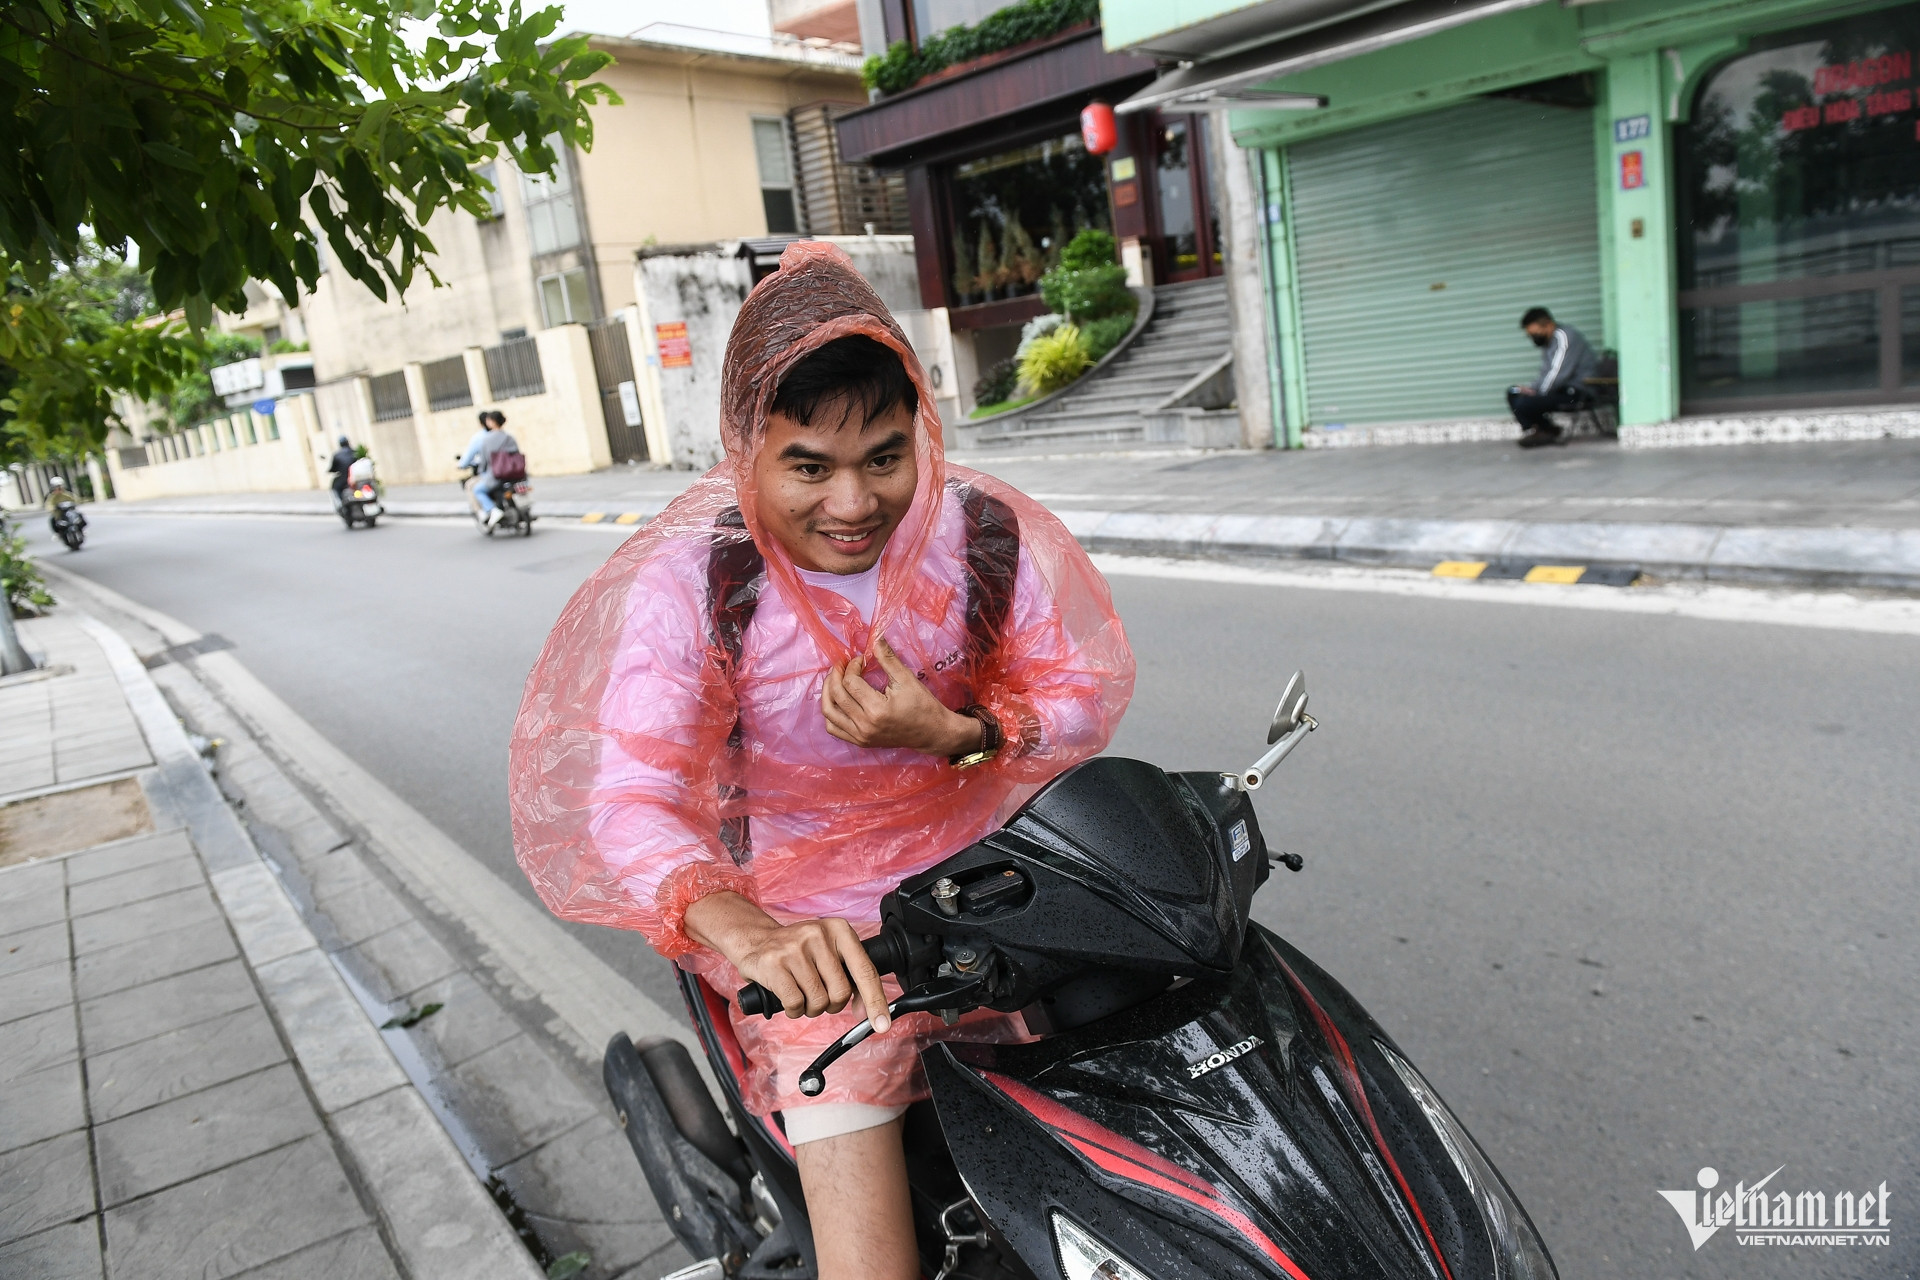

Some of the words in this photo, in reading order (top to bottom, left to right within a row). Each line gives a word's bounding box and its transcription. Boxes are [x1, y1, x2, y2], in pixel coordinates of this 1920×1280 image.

[1814, 51, 1911, 95] DRAGON
[1618, 117, 1649, 140] 177
[1187, 1035, 1264, 1079] HONDA
